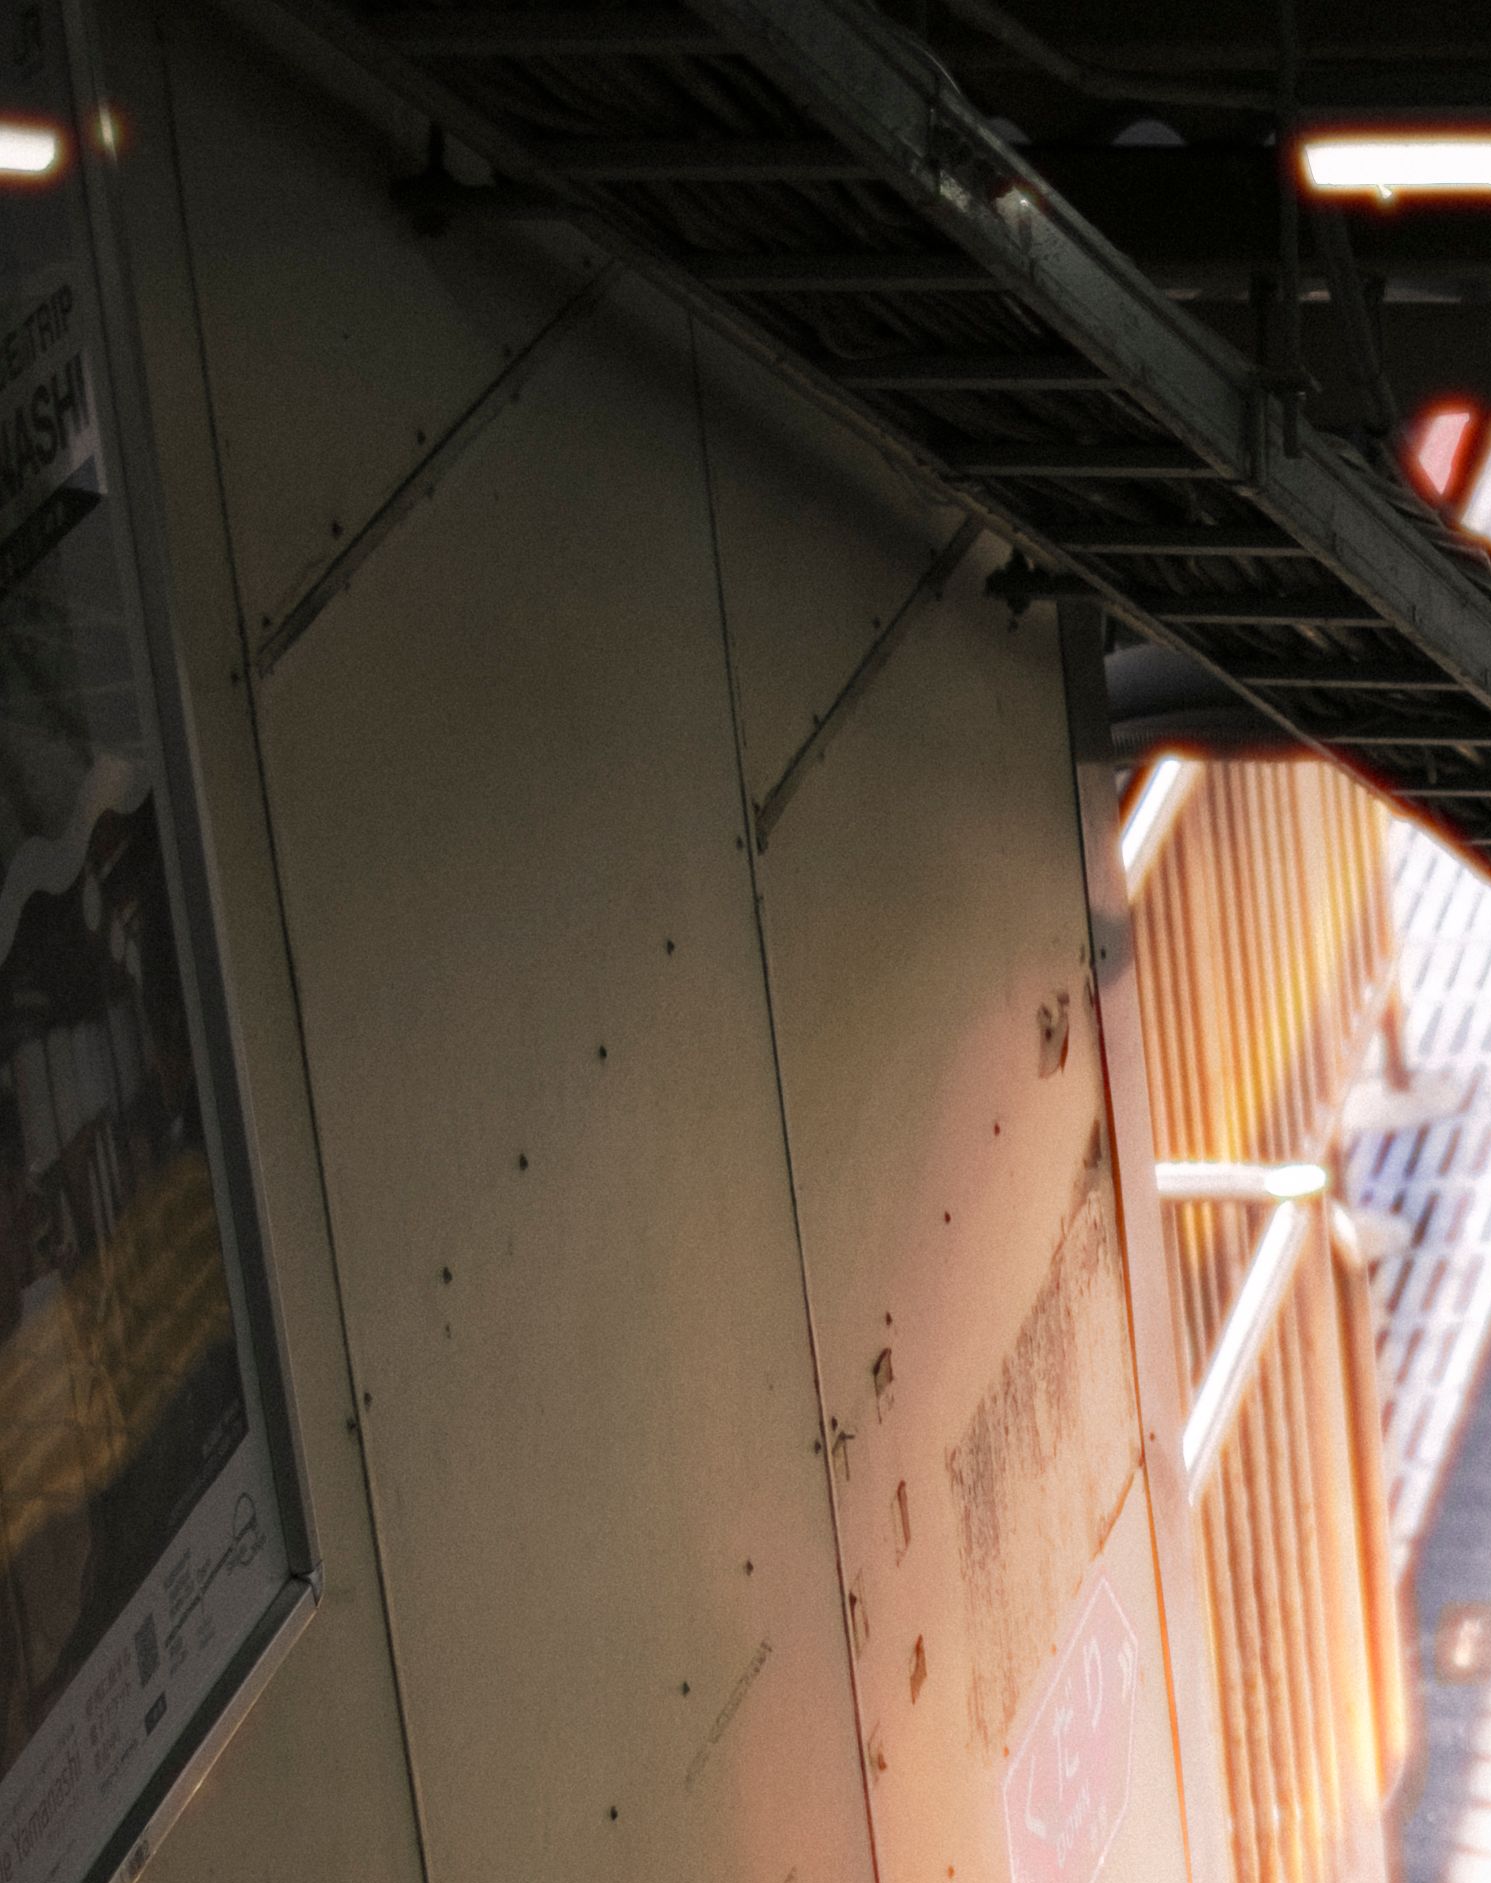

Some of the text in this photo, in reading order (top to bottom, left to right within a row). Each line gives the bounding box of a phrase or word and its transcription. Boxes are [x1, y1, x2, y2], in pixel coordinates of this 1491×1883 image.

[24, 284, 74, 360] TRIP
[12, 1736, 82, 1864] Yamanashi
[1024, 1635, 1135, 1840] くだり
